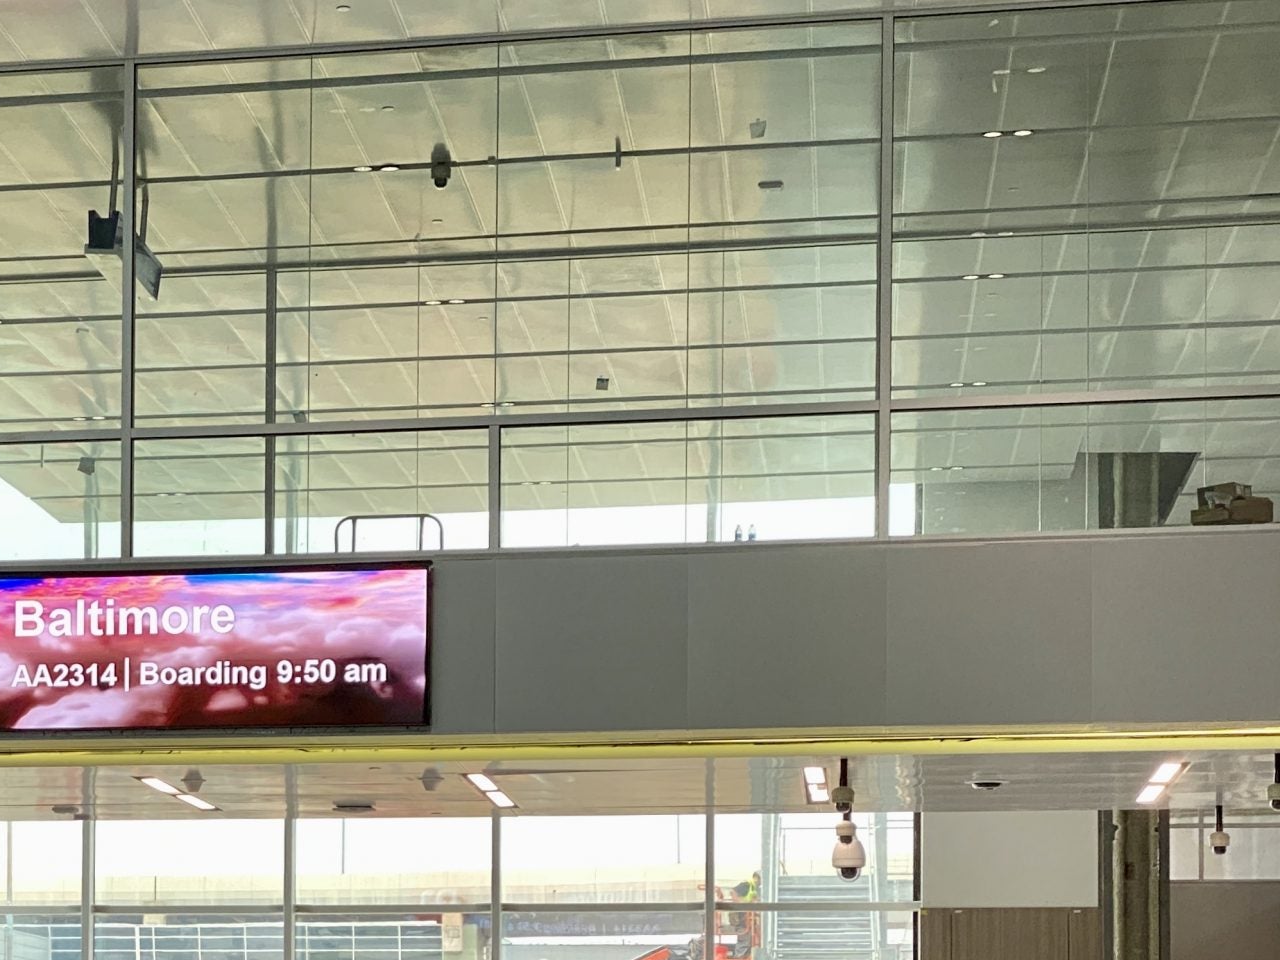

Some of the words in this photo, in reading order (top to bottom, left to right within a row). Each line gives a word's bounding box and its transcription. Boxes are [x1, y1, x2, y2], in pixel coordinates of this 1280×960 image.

[13, 598, 236, 638] Baltimore
[11, 661, 117, 688] AA2314
[140, 660, 267, 690] Boarding
[276, 659, 337, 685] 9:50
[343, 663, 388, 684] am
